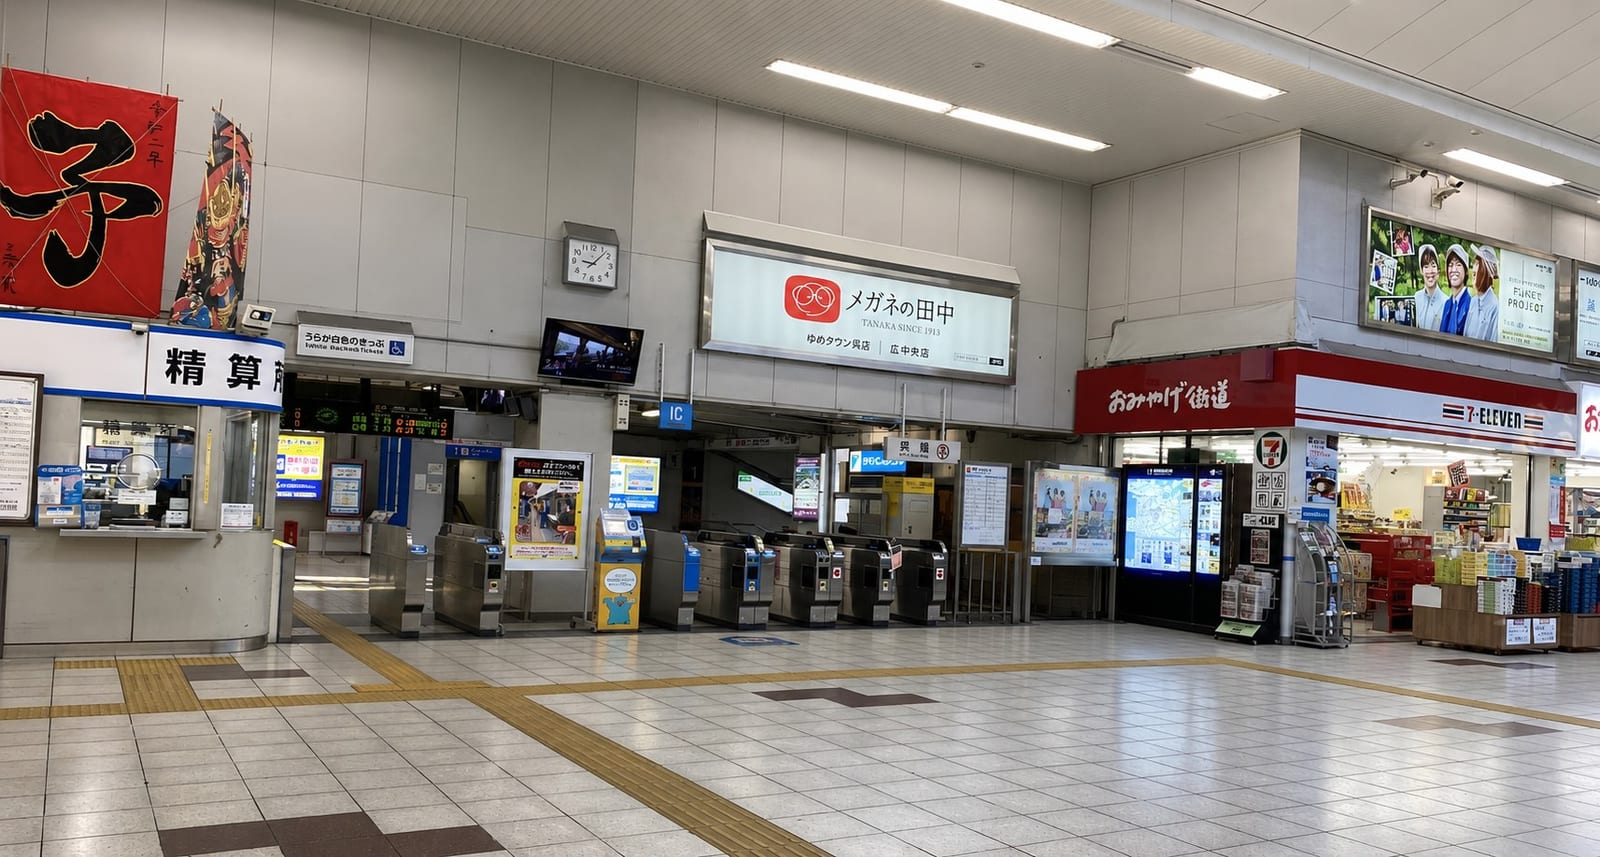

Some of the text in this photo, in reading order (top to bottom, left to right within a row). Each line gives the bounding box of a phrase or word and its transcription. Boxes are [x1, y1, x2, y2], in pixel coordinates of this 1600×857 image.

[0, 110, 163, 289] 子
[846, 290, 955, 325] メガネの田中
[1508, 298, 1544, 313] PROJECT
[861, 319, 940, 336] TANAKA SINCE 1913
[305, 332, 384, 348] うらが白色のきっぷ
[806, 333, 870, 351] ゆめタウン呉店
[890, 344, 929, 359] 広中央店
[1108, 379, 1231, 414] おみやげ街道
[670, 406, 683, 420] IC
